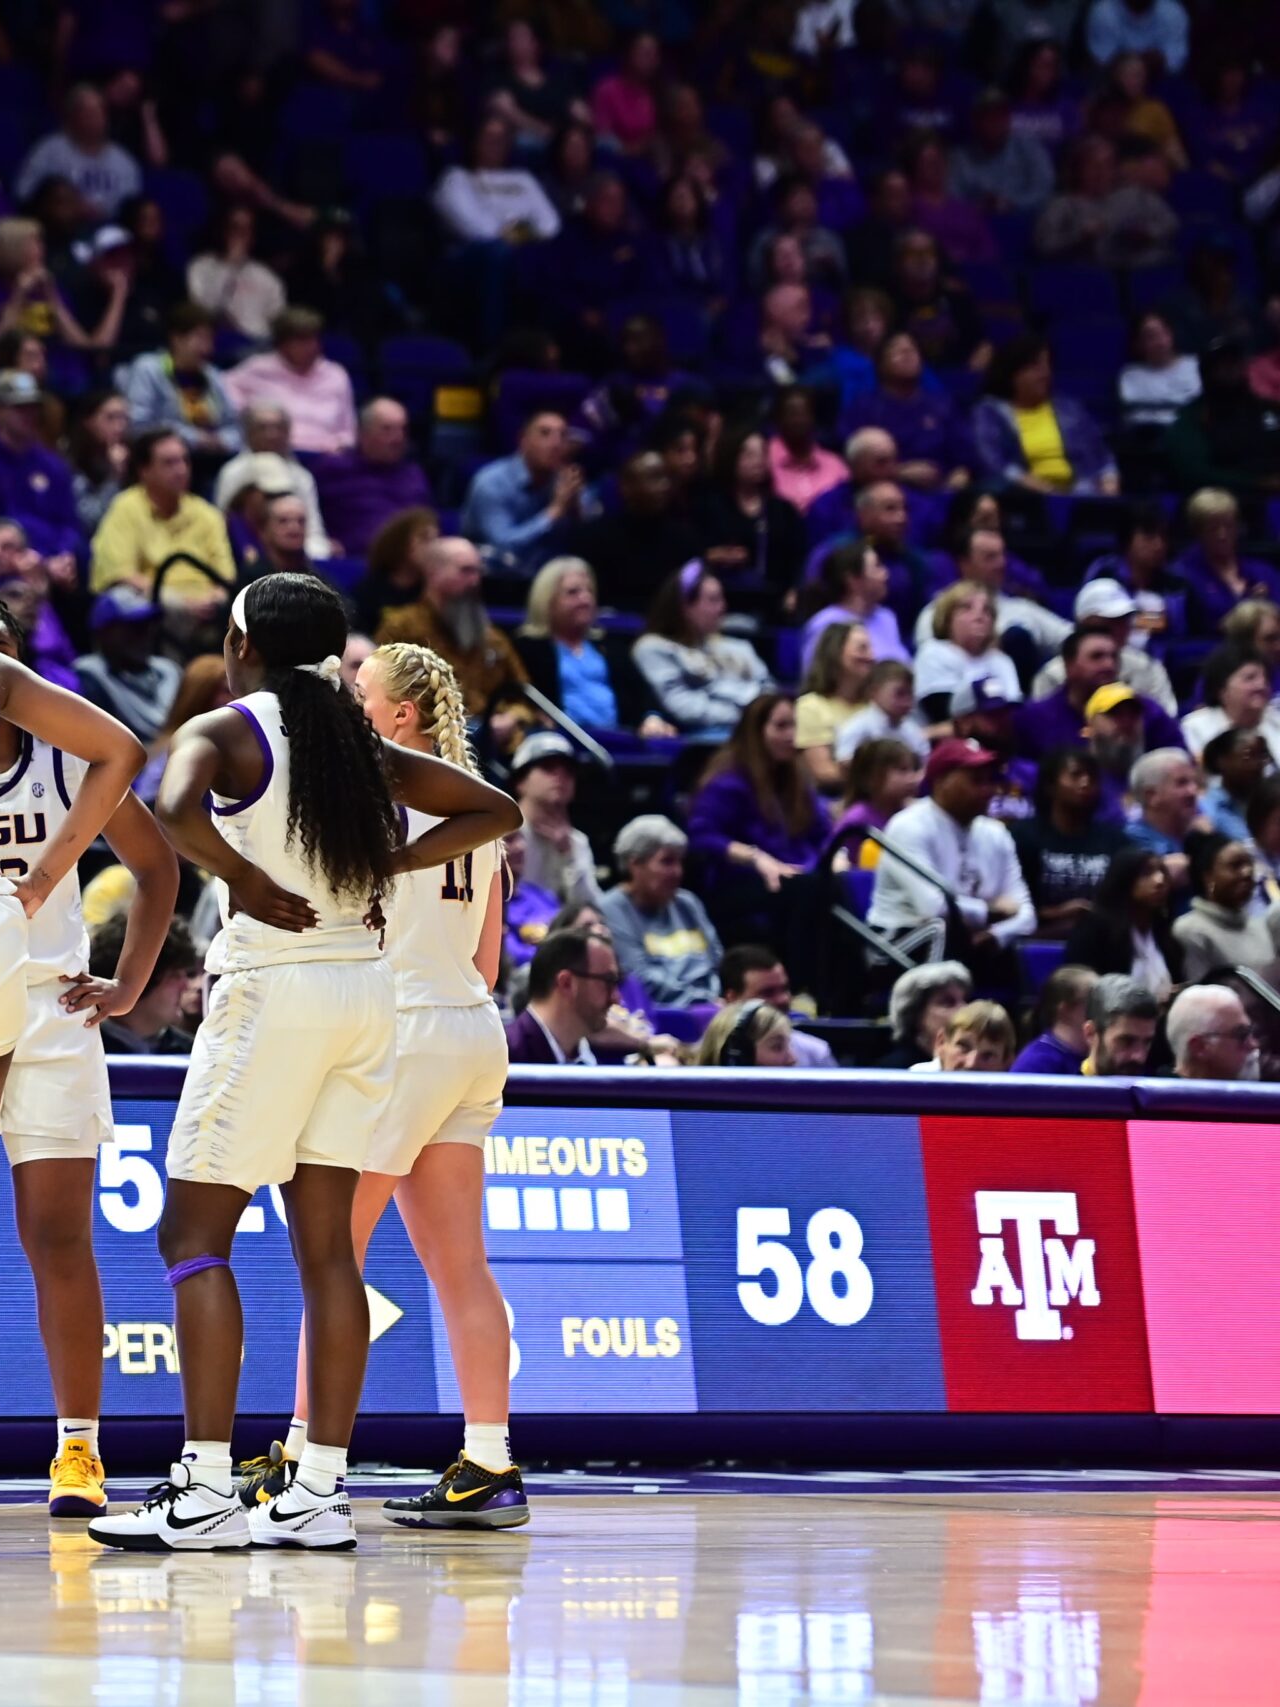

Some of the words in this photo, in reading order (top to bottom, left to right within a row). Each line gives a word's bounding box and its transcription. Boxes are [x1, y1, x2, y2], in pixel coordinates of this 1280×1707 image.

[484, 1136, 649, 1177] IMEOUTS
[735, 1205, 875, 1326] 58
[561, 1317, 682, 1358] FOULS
